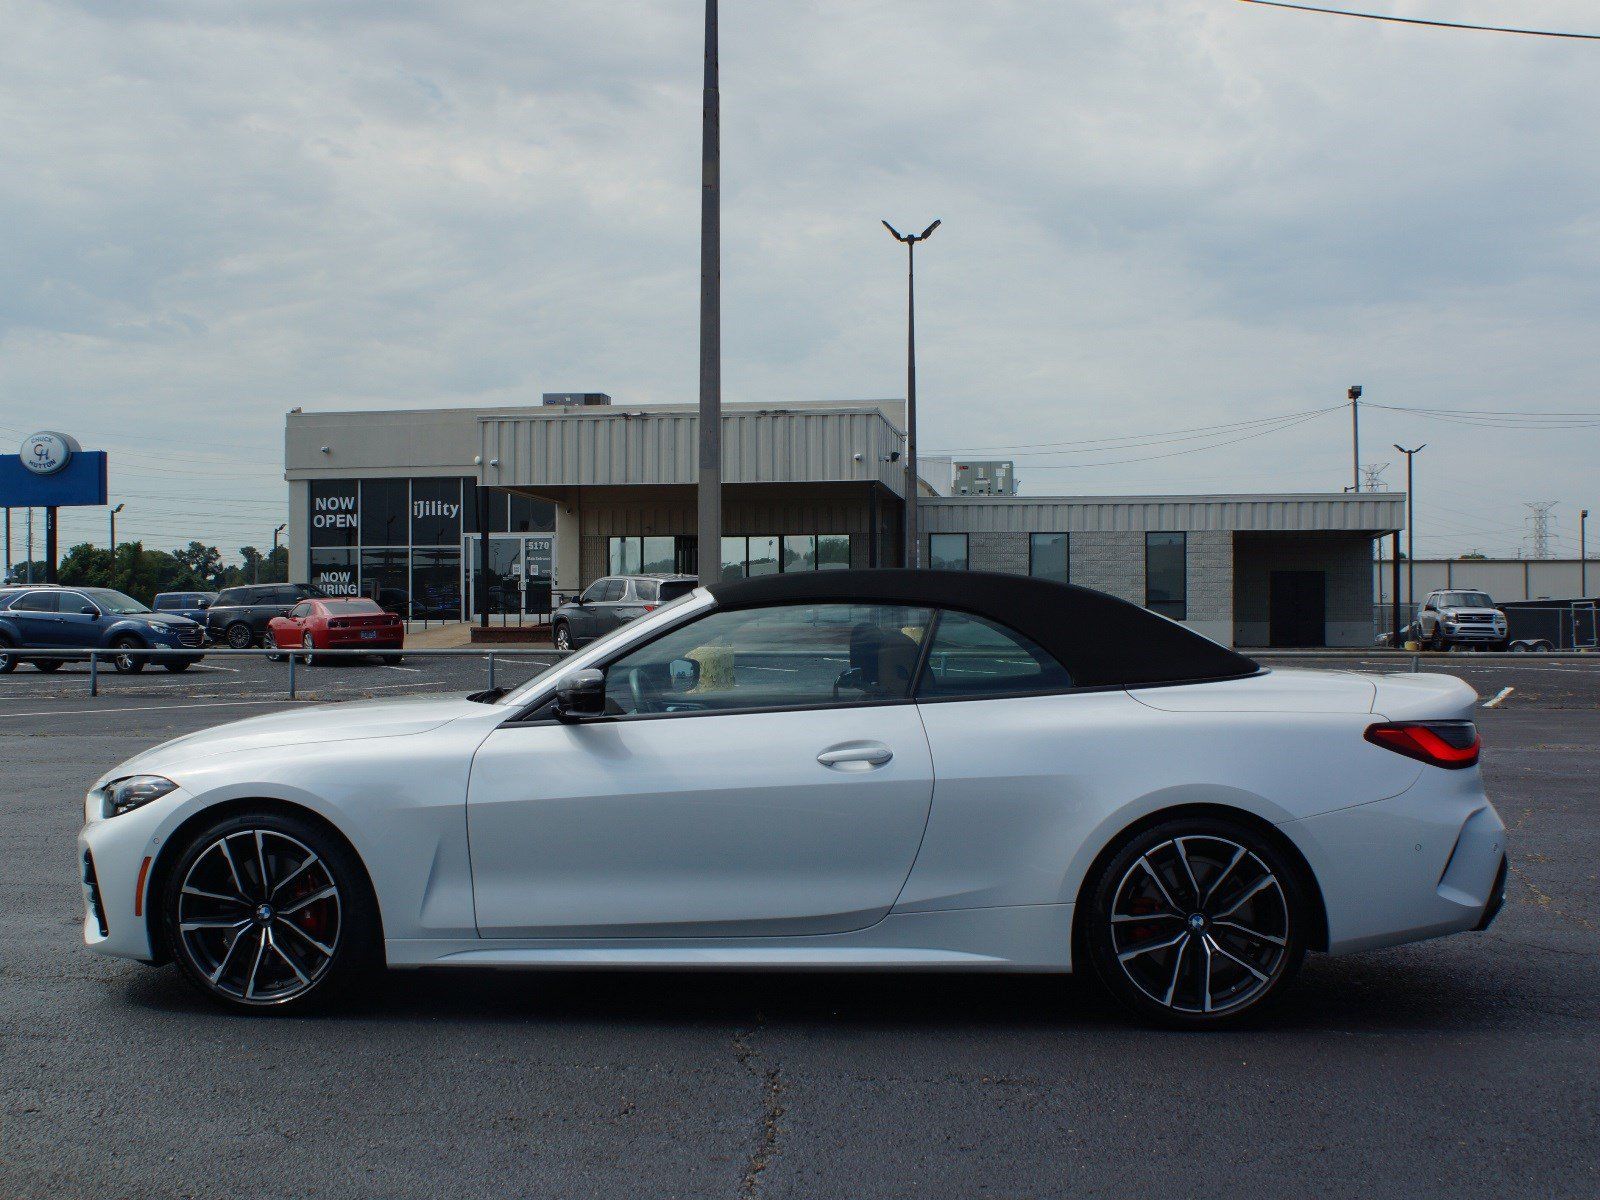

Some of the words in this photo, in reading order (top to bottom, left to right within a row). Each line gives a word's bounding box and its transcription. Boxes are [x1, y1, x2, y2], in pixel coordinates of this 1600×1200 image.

[30, 436, 54, 444] CHUCK
[28, 459, 57, 469] HUTTON
[315, 496, 355, 511] NOW
[313, 513, 358, 528] OPEN
[528, 541, 550, 550] 5170
[320, 571, 351, 583] NOW
